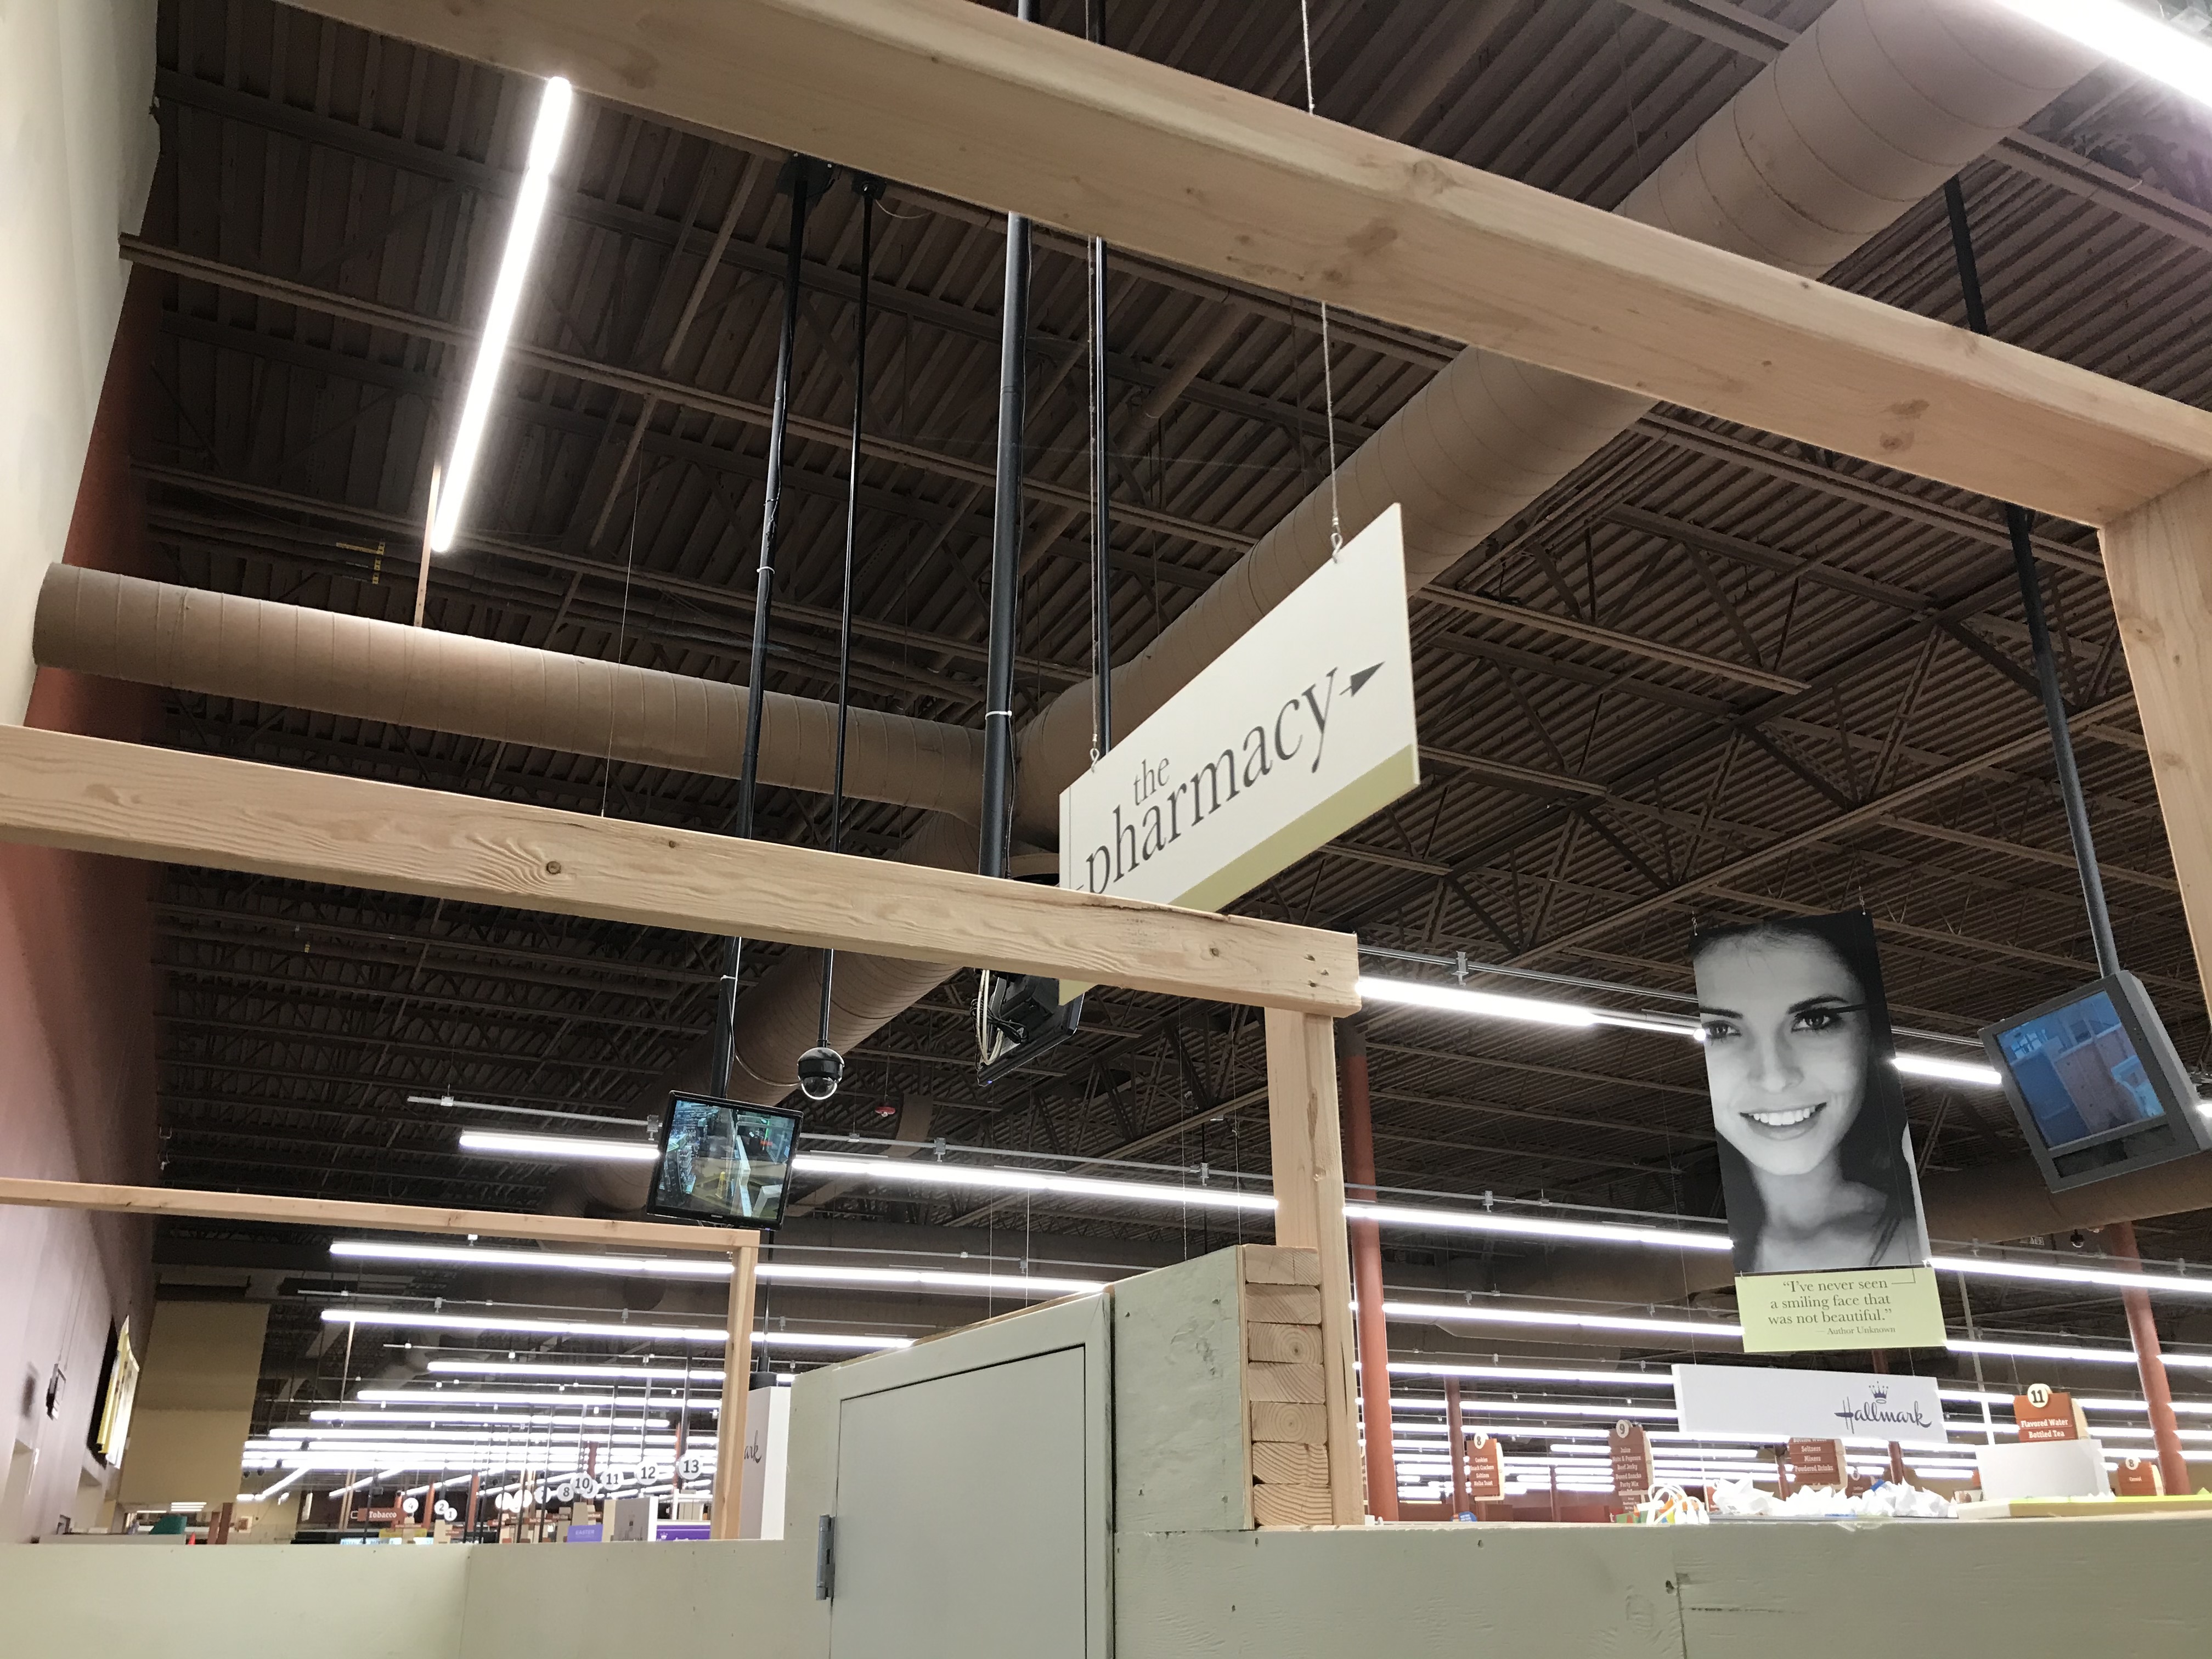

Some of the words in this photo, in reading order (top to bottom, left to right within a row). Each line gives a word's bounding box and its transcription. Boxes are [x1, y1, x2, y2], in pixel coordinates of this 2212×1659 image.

[1086, 667, 1338, 895] pharmacy
[1133, 758, 1170, 806] the
[1818, 1282, 1854, 1291] never
[1859, 1280, 1888, 1289] seen
[1770, 1300, 1778, 1309] a
[1782, 1295, 1830, 1311] smiling
[1832, 1294, 1859, 1306] face
[1864, 1293, 1891, 1305] that
[1768, 1316, 1793, 1325] was
[1796, 1313, 1818, 1324] not
[1857, 1325, 1896, 1334] Unknown
[2031, 1390, 2045, 1403] 11
[1834, 1396, 1932, 1434] Hallmark
[2021, 1419, 2048, 1427] Flavored
[1620, 1424, 1625, 1434] 9
[2028, 1430, 2052, 1438] Bottled
[1477, 1436, 1481, 1446] 8
[683, 1459, 699, 1474] 13
[2128, 1459, 2134, 1468] 8
[641, 1466, 656, 1480] 12
[575, 1477, 590, 1489] 10
[606, 1474, 619, 1485] 11
[563, 1487, 570, 1497] 8
[439, 1503, 444, 1511] 2
[368, 1510, 397, 1519] Tobacco
